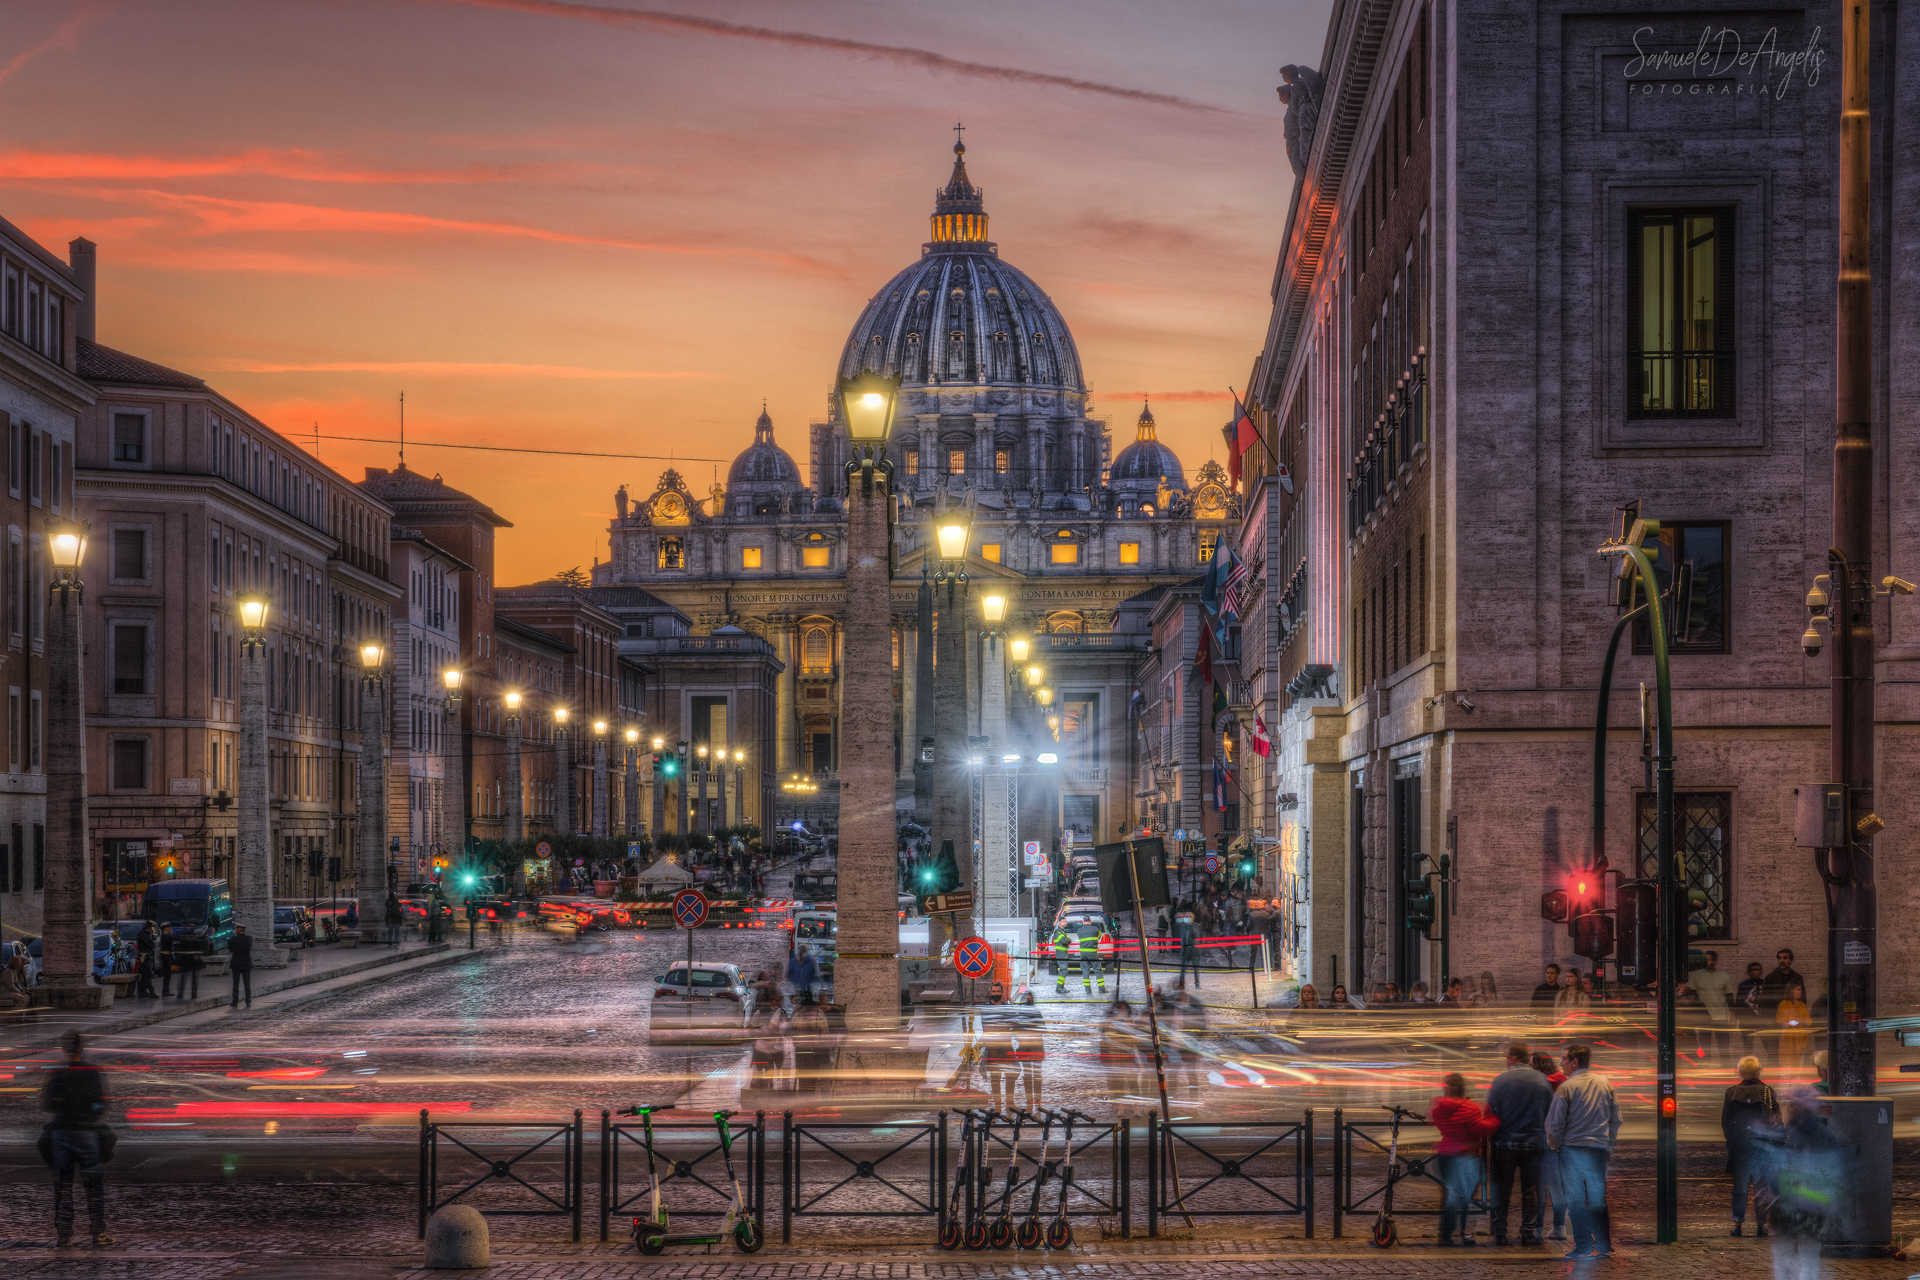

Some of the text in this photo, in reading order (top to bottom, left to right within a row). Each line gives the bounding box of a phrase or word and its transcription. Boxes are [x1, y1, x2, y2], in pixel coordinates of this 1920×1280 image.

[710, 594, 722, 602] IN
[726, 594, 776, 602] HONOREM
[779, 593, 829, 601] PRINCIPIS
[1021, 590, 1046, 599] PONT
[1047, 590, 1069, 598] MAX
